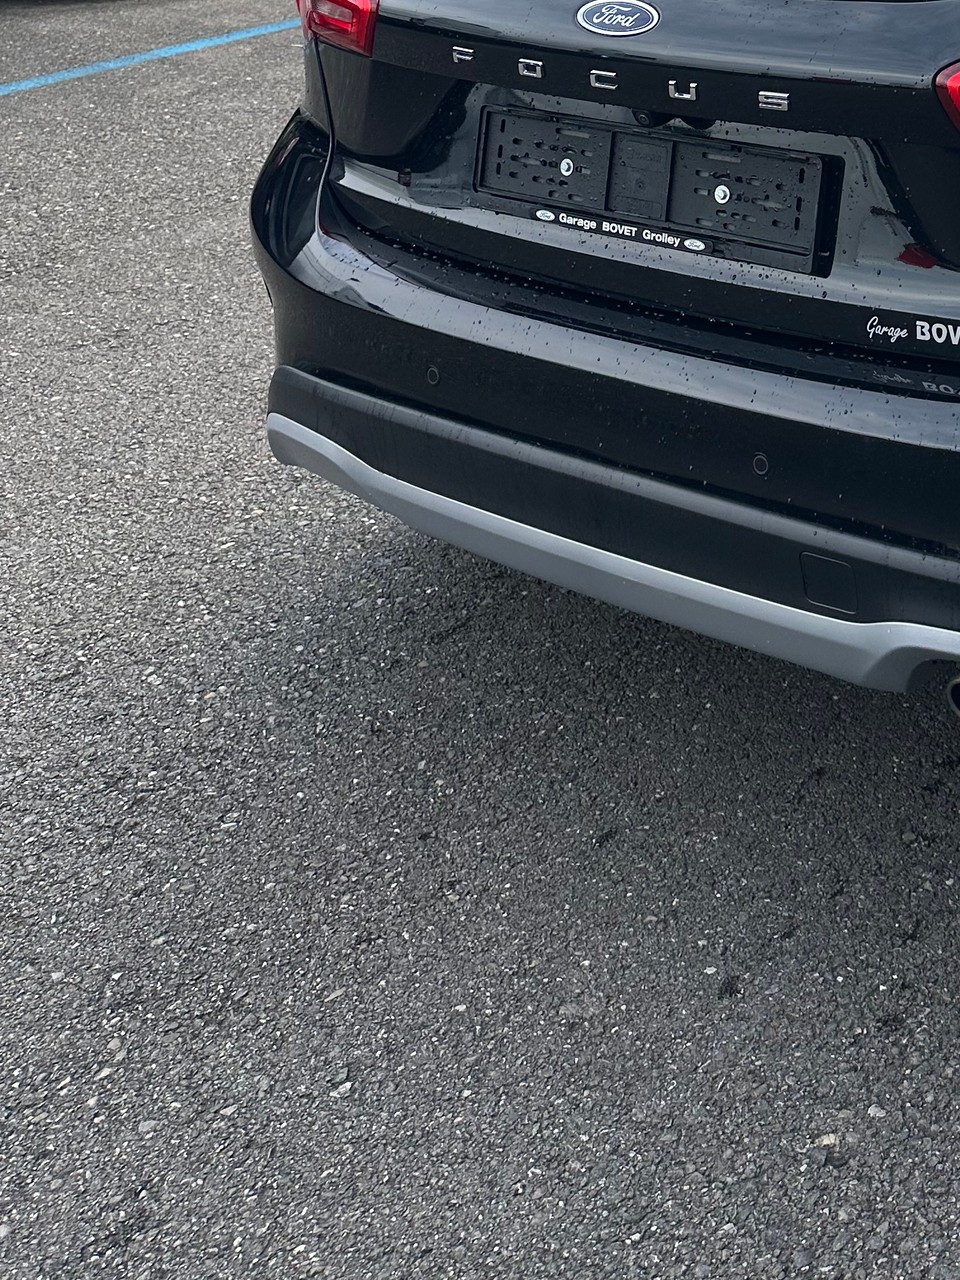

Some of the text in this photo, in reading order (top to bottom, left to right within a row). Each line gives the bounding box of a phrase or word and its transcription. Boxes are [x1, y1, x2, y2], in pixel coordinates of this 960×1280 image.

[592, 4, 640, 27] Ford
[452, 46, 790, 112] FOCUS
[558, 213, 597, 229] Garage
[602, 222, 637, 237] BOVET
[642, 229, 681, 247] Grolley
[867, 316, 908, 342] Garage
